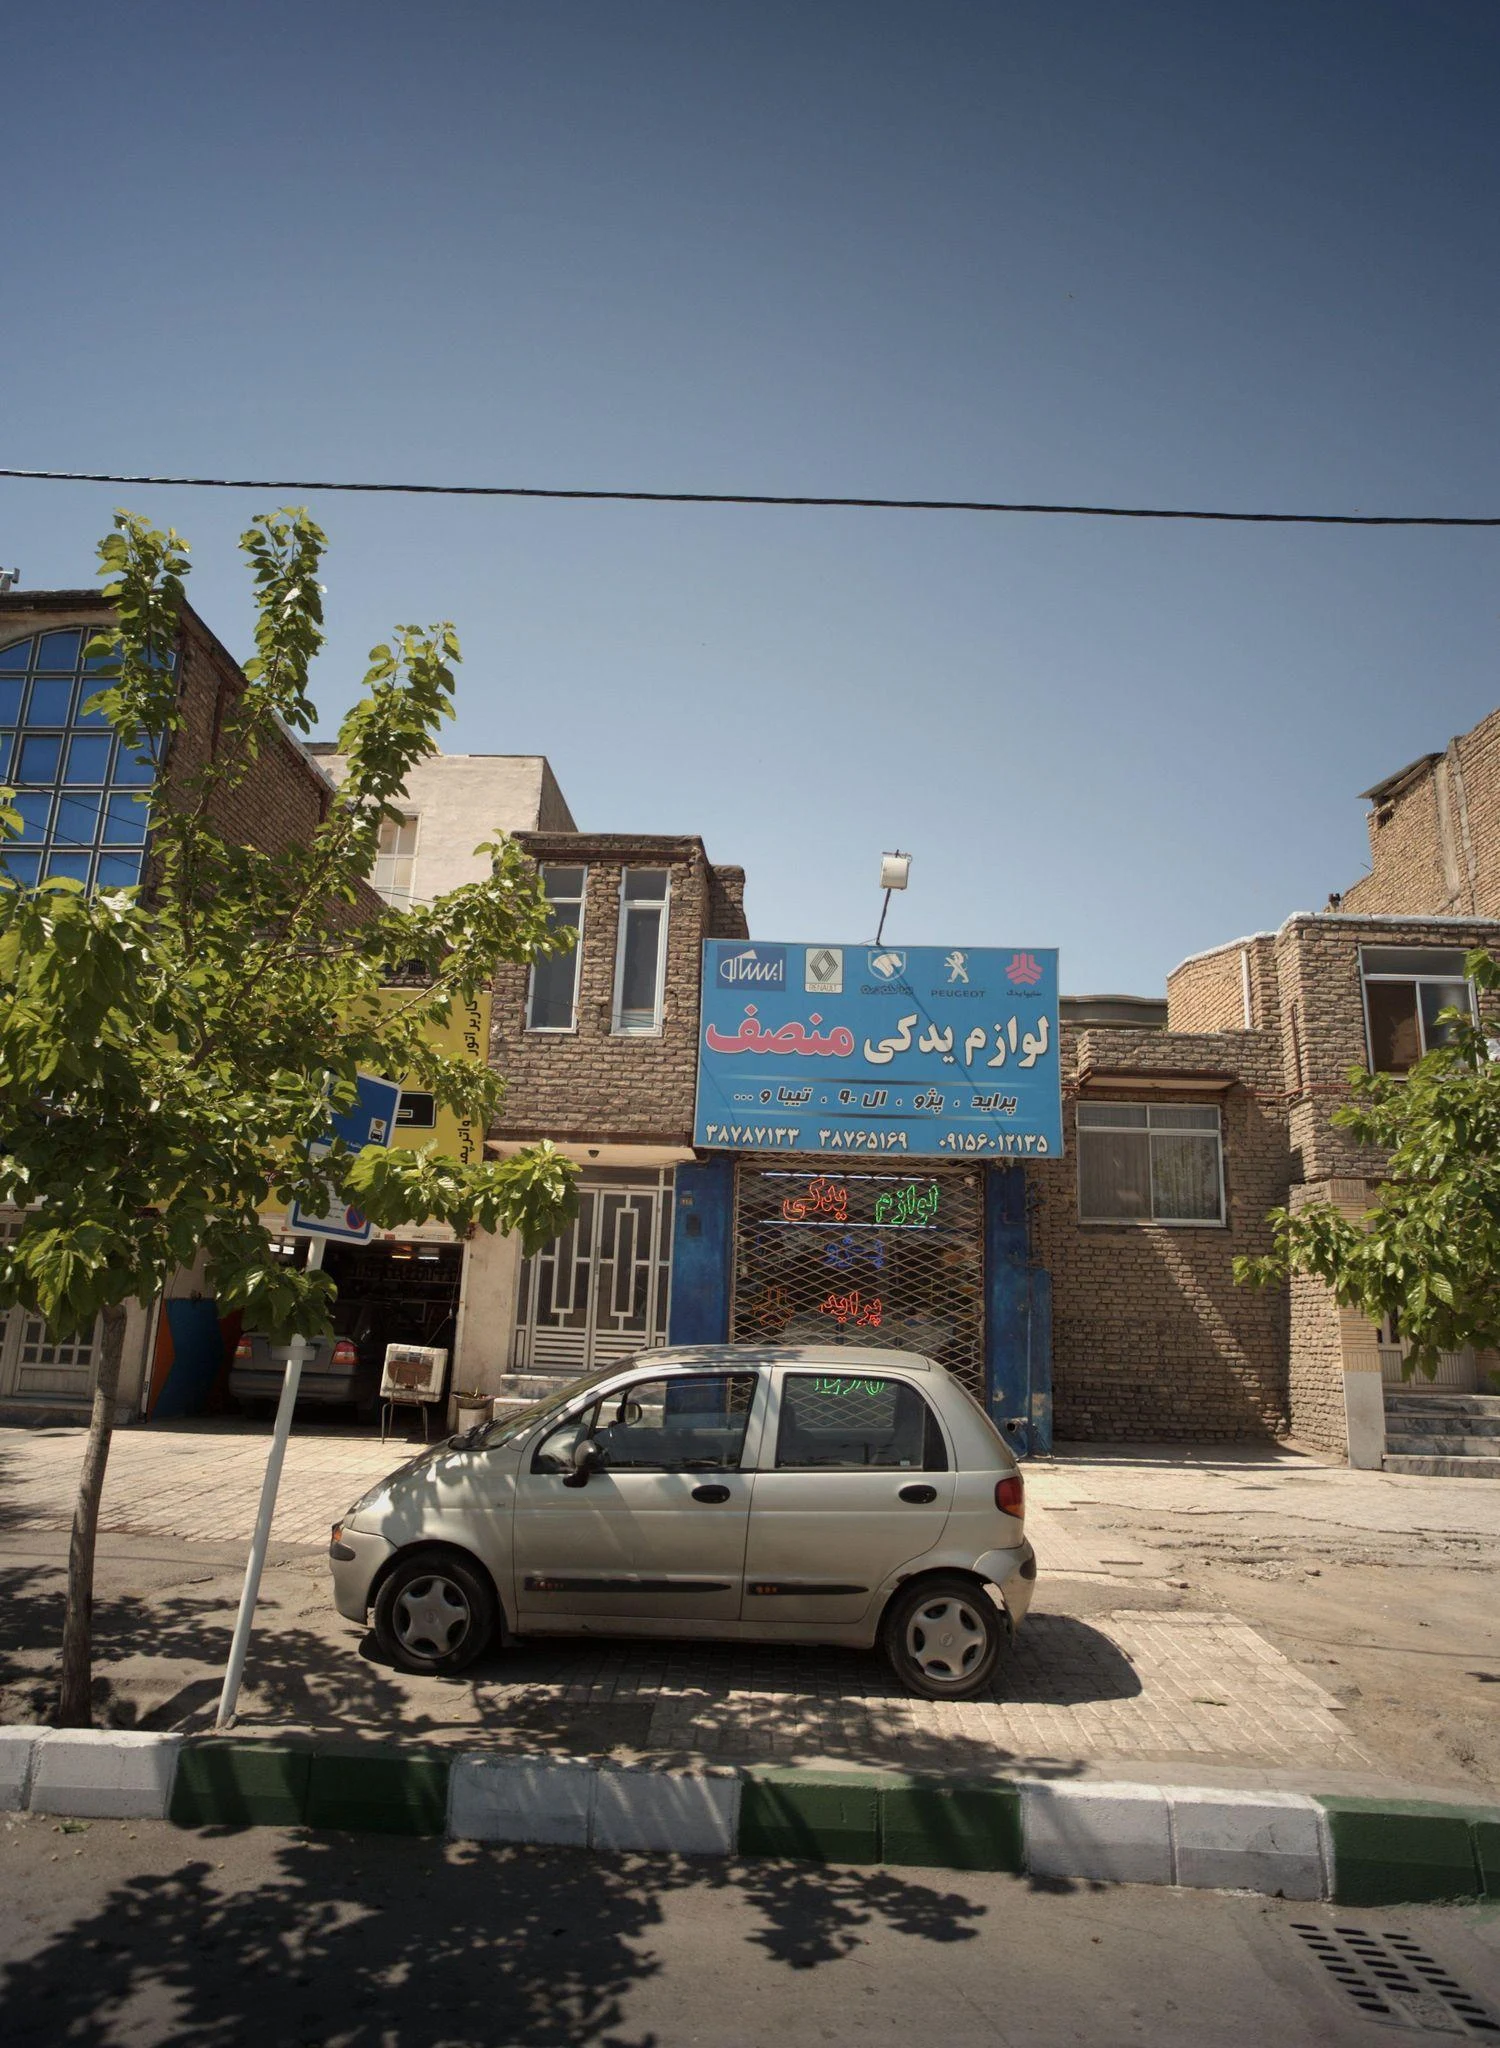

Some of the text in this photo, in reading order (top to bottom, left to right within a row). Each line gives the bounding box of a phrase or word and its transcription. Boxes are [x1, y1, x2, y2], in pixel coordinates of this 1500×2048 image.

[931, 989, 987, 998] PEUGEOT
[705, 1003, 1050, 1068] لوازم یدکی منصف
[776, 1086, 813, 1107] تیبا
[861, 1089, 888, 1109] ال
[913, 1088, 945, 1115] پژو
[971, 1094, 1018, 1115] پراید
[705, 1123, 1049, 1153] ۰۹۱۵۶۰۱۲۱۳۵ ۳۸۷۶۵۱۶۹ ۳۸۷۸۷۱۳۳
[782, 1177, 939, 1225] لوازم یدکی
[819, 1291, 883, 1327] پراید
